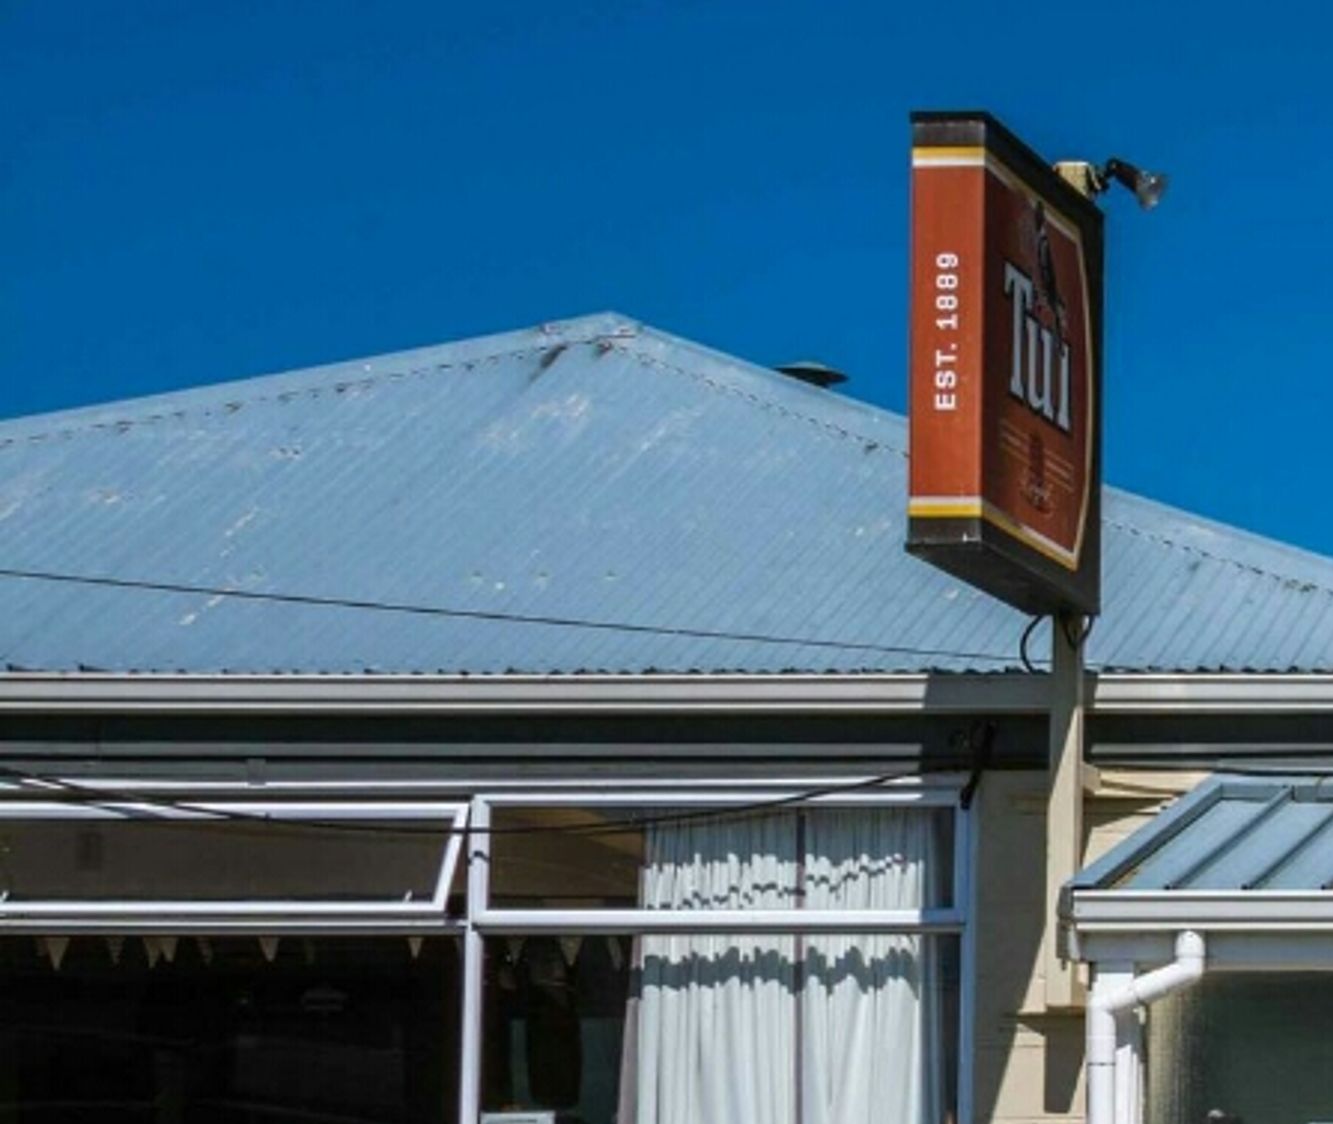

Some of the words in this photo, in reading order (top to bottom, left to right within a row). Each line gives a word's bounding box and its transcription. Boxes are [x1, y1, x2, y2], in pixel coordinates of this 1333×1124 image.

[934, 252, 959, 329] 1889
[934, 343, 958, 411] EST.
[1003, 260, 1071, 432] Tui
